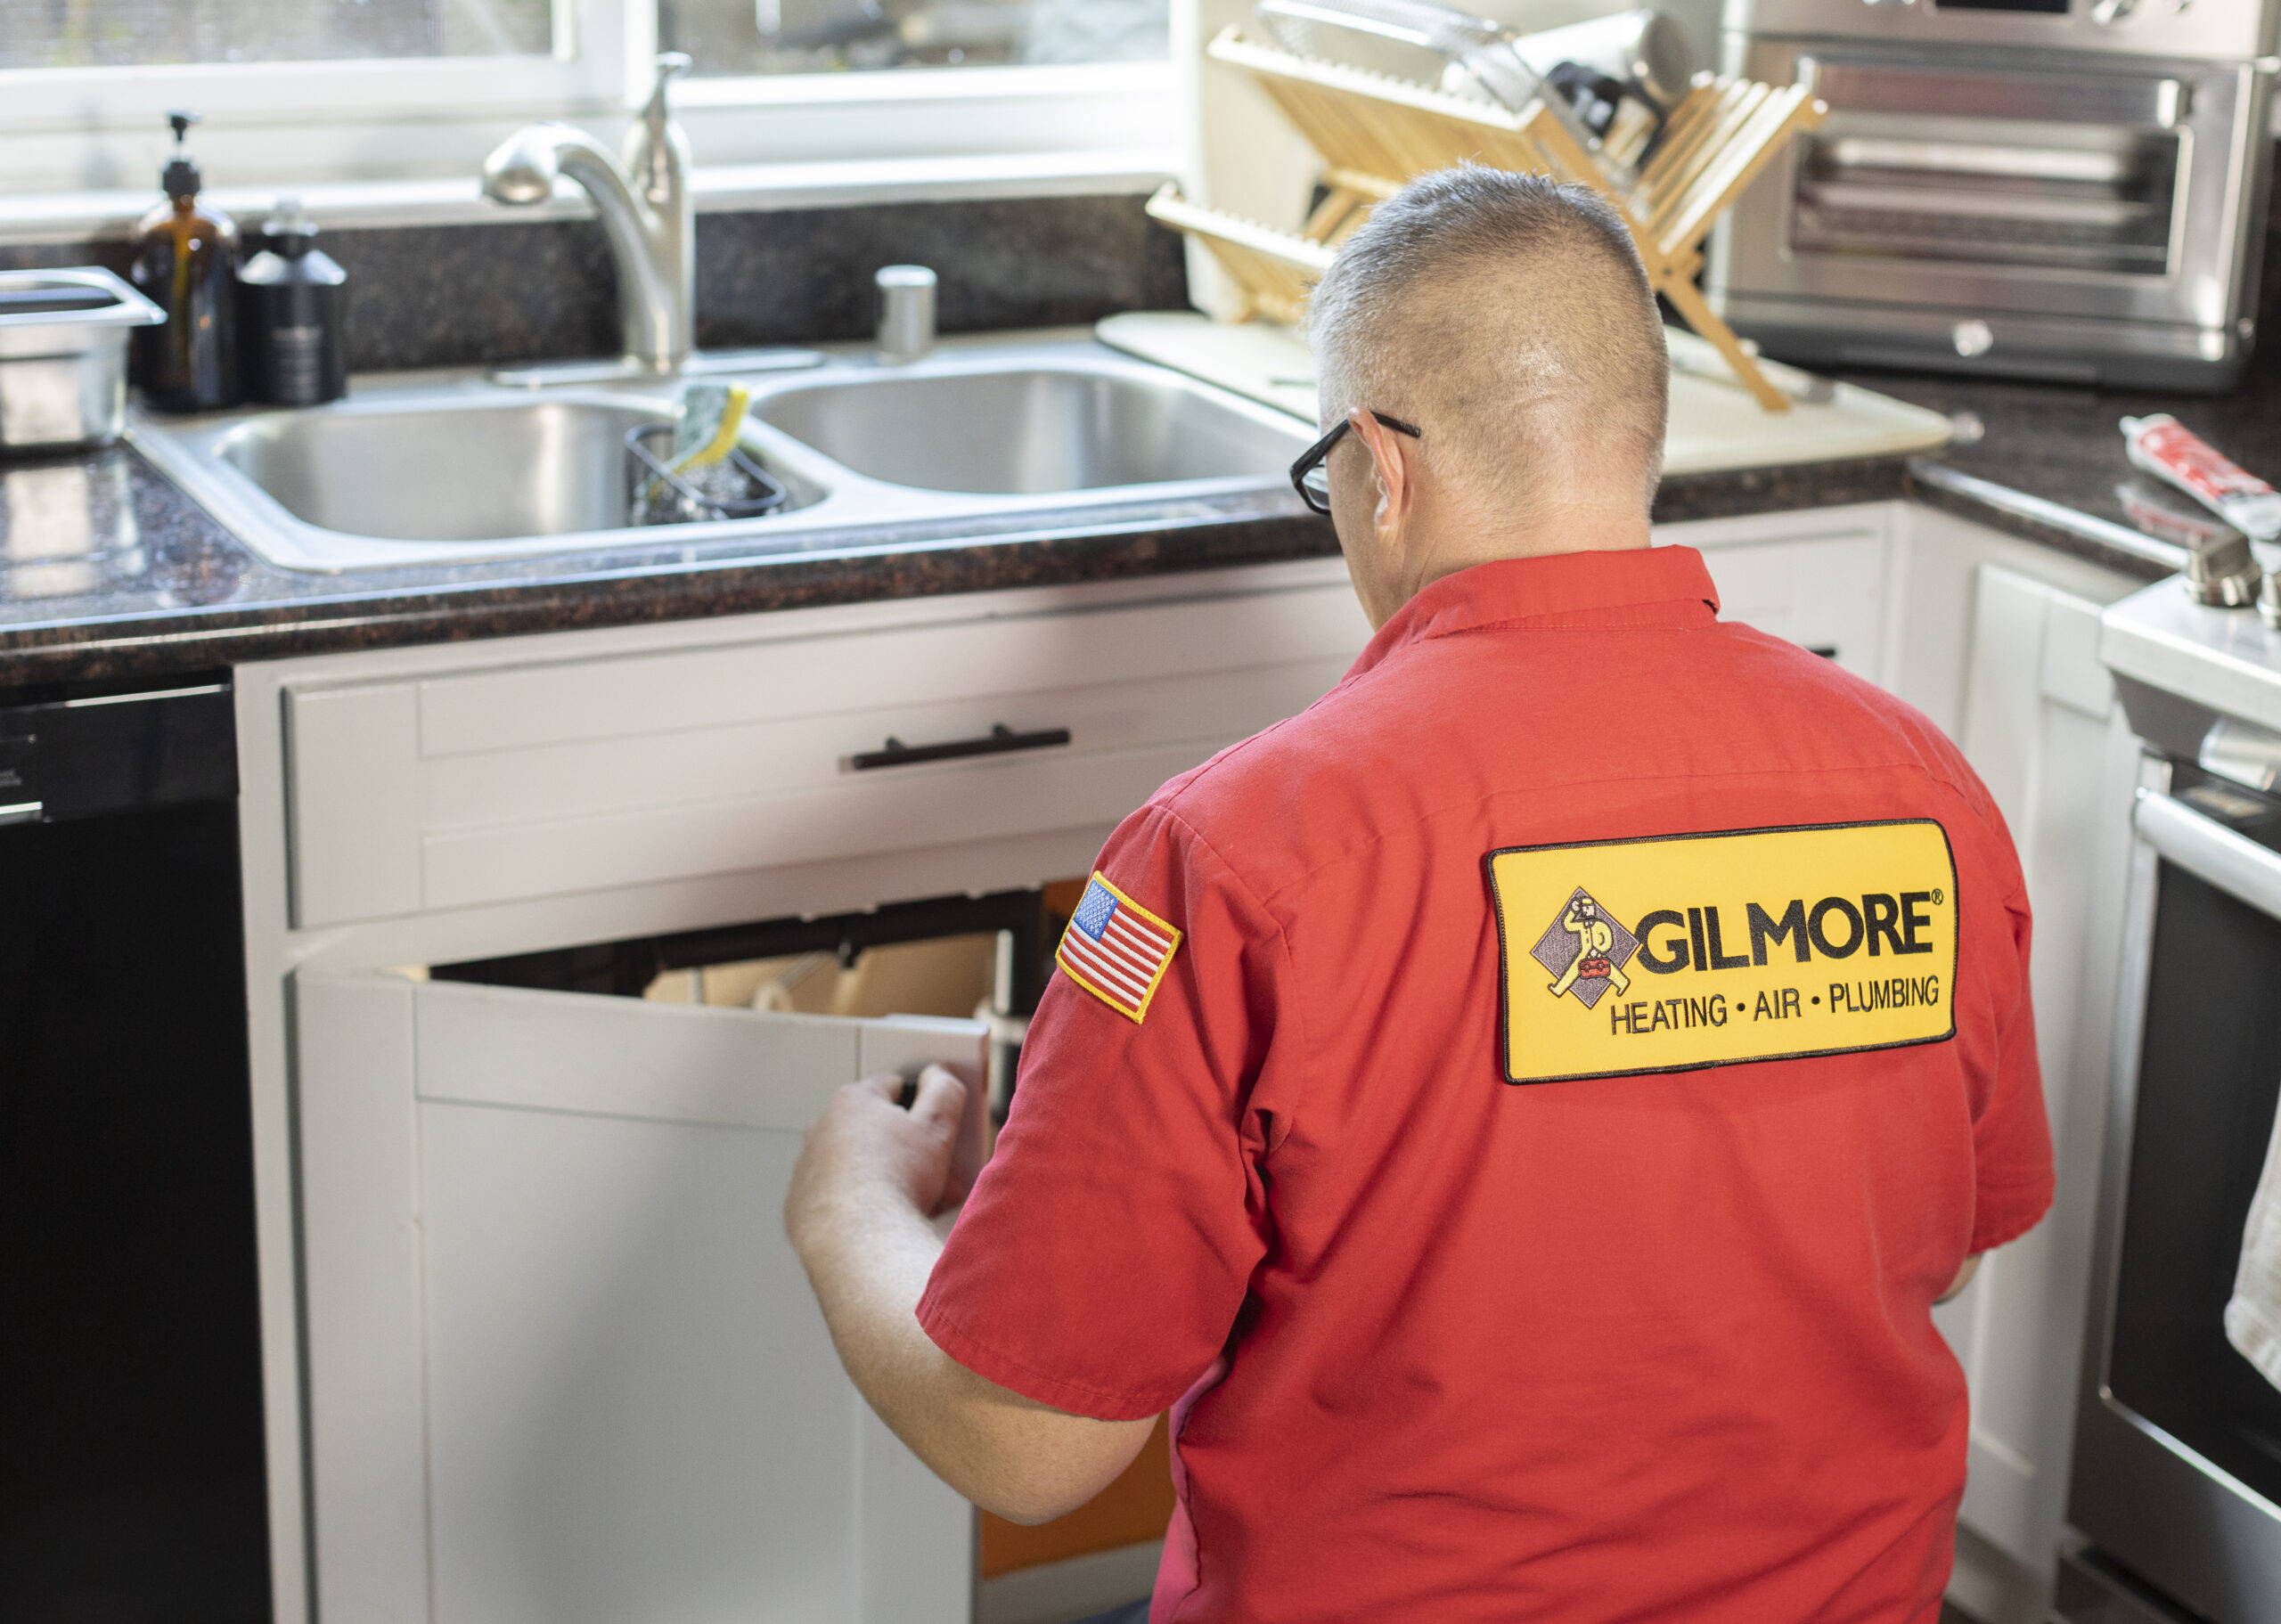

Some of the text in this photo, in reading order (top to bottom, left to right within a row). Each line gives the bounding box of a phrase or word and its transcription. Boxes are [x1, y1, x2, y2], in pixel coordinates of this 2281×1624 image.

[1610, 975, 1939, 1035] HEATING AIR PLUMBING
